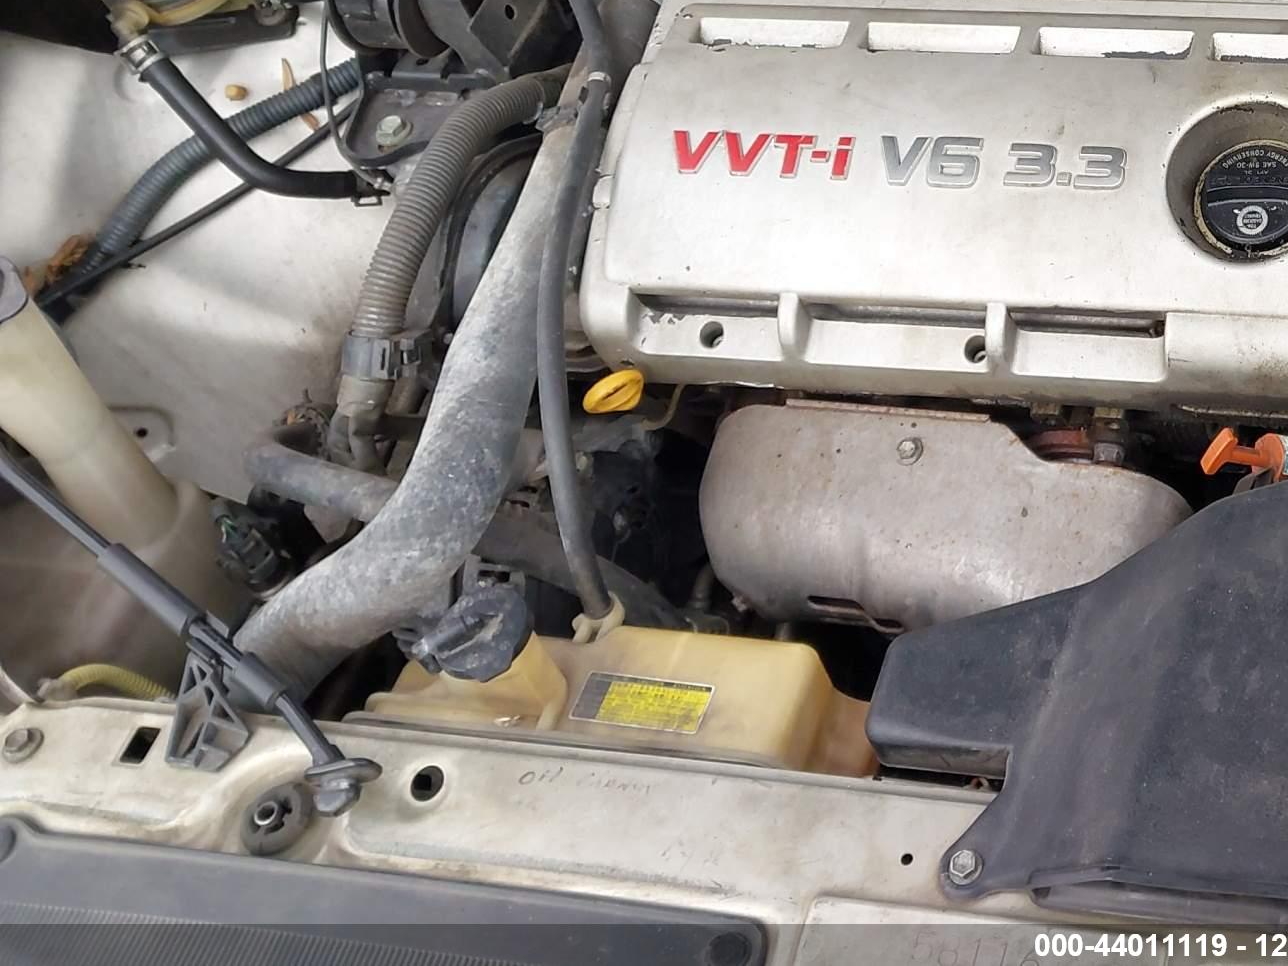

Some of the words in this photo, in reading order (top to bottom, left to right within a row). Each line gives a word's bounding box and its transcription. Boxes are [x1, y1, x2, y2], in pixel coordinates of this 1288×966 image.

[672, 129, 857, 180] VVT-i
[881, 135, 985, 189] V6
[1003, 142, 1128, 190] 3.3
[1222, 148, 1265, 169] CONSERVING
